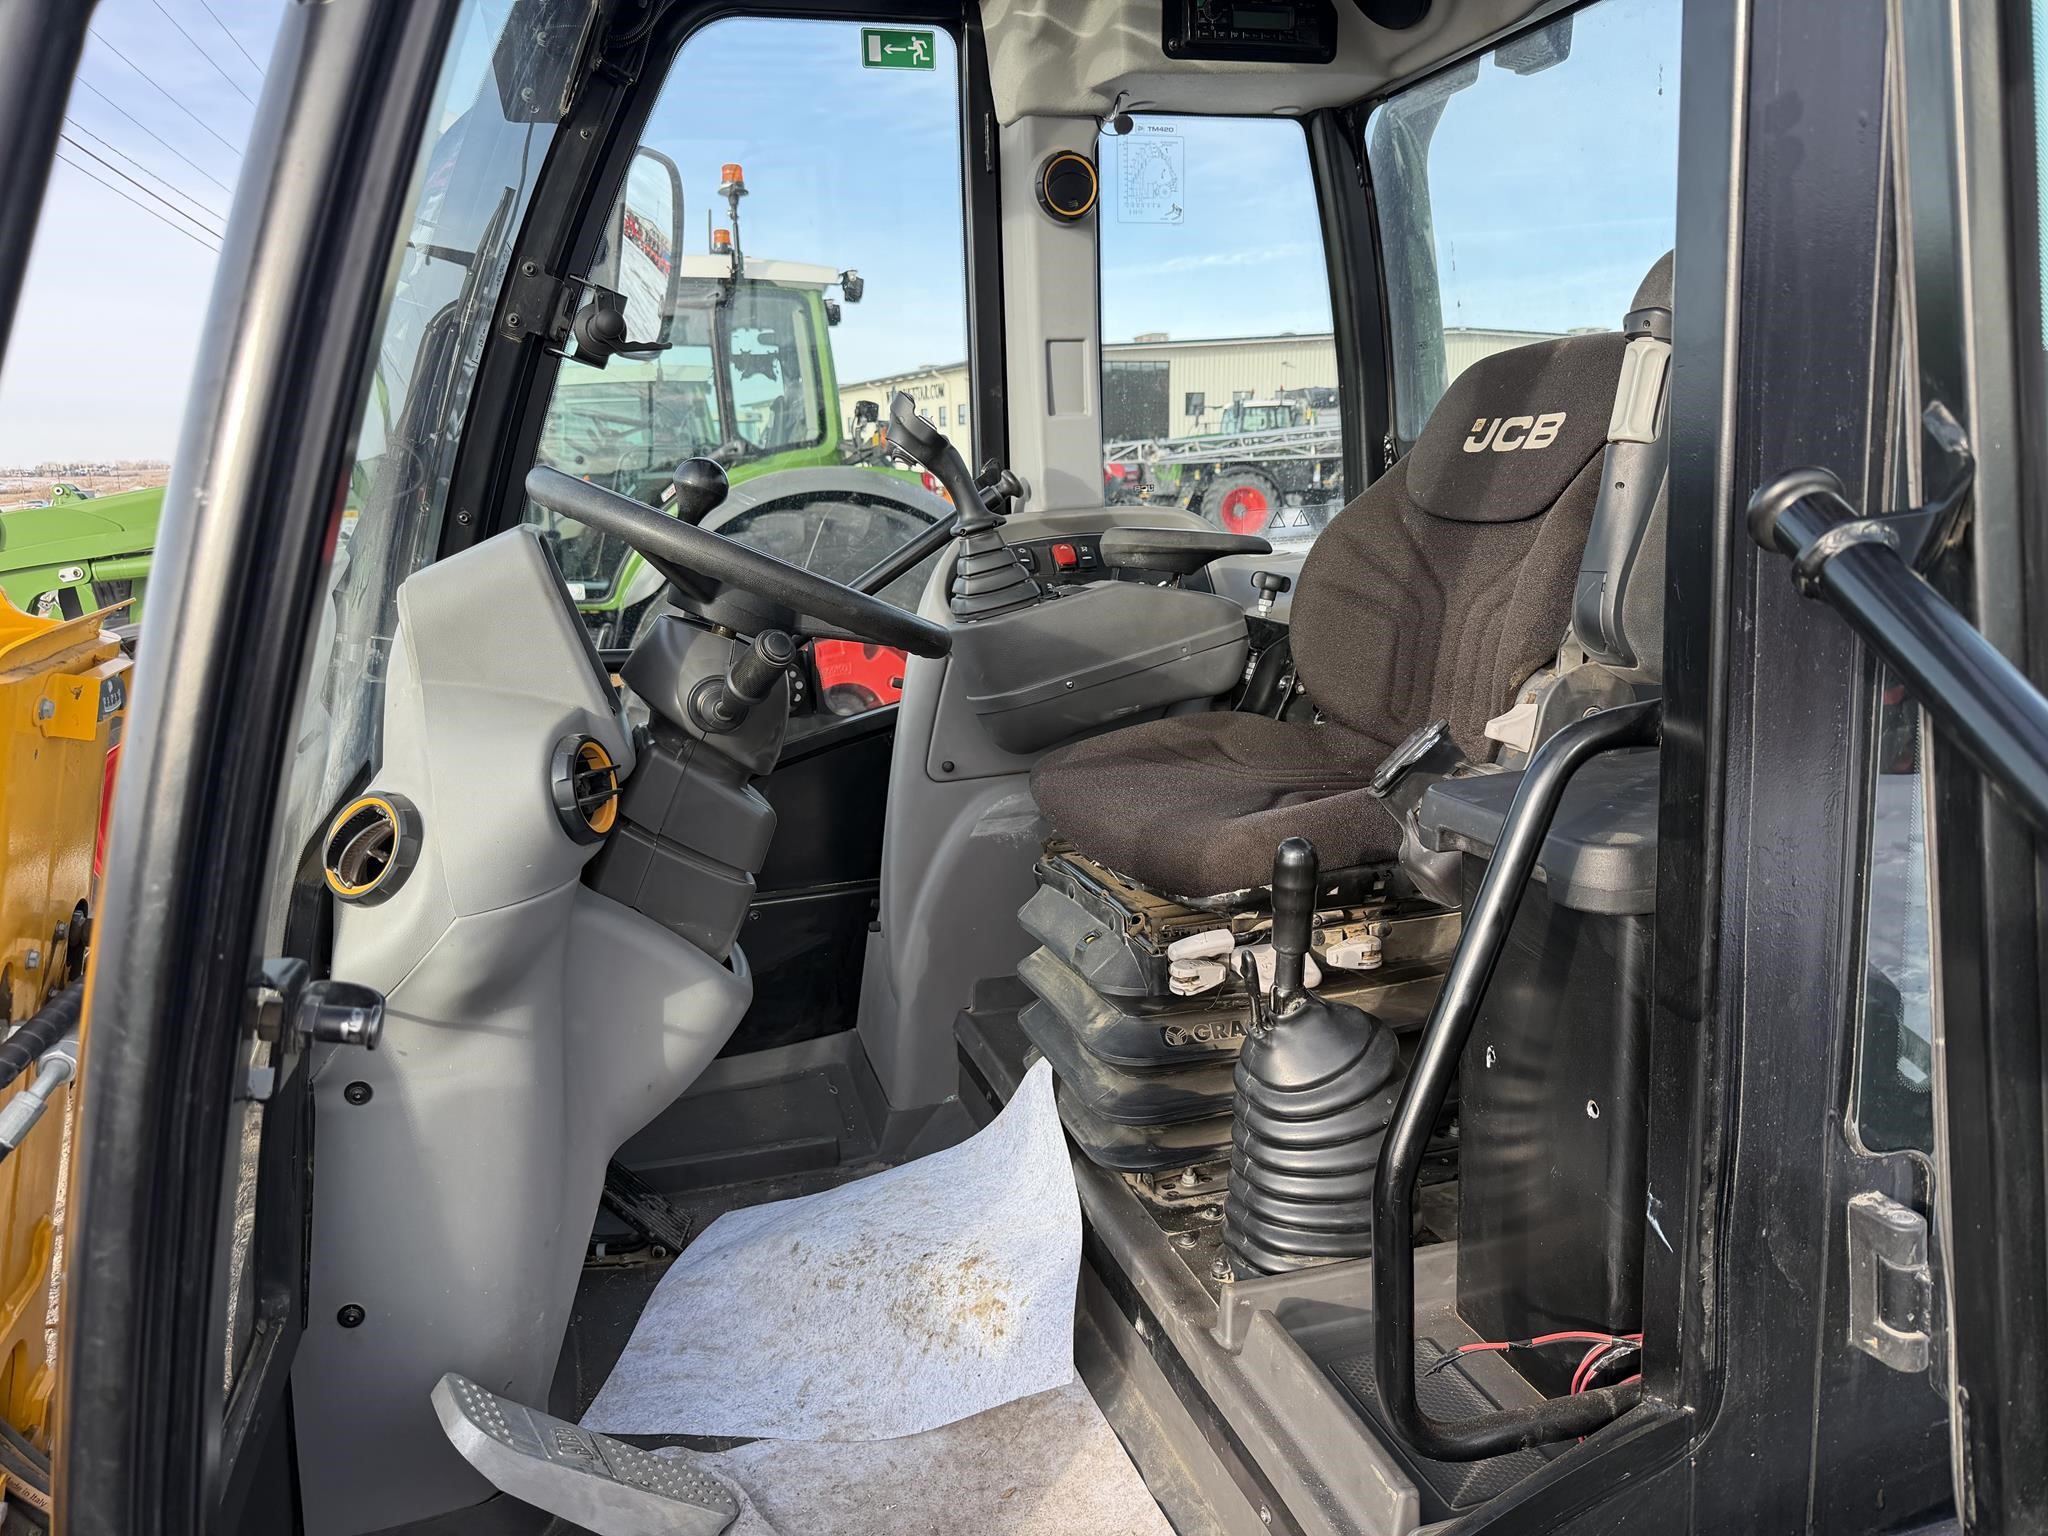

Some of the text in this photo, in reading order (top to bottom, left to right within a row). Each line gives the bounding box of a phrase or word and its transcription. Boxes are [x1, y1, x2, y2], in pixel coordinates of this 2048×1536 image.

[1147, 125, 1175, 133] TM420
[1463, 411, 1567, 453] JCB
[30, 1492, 49, 1508] Italy
